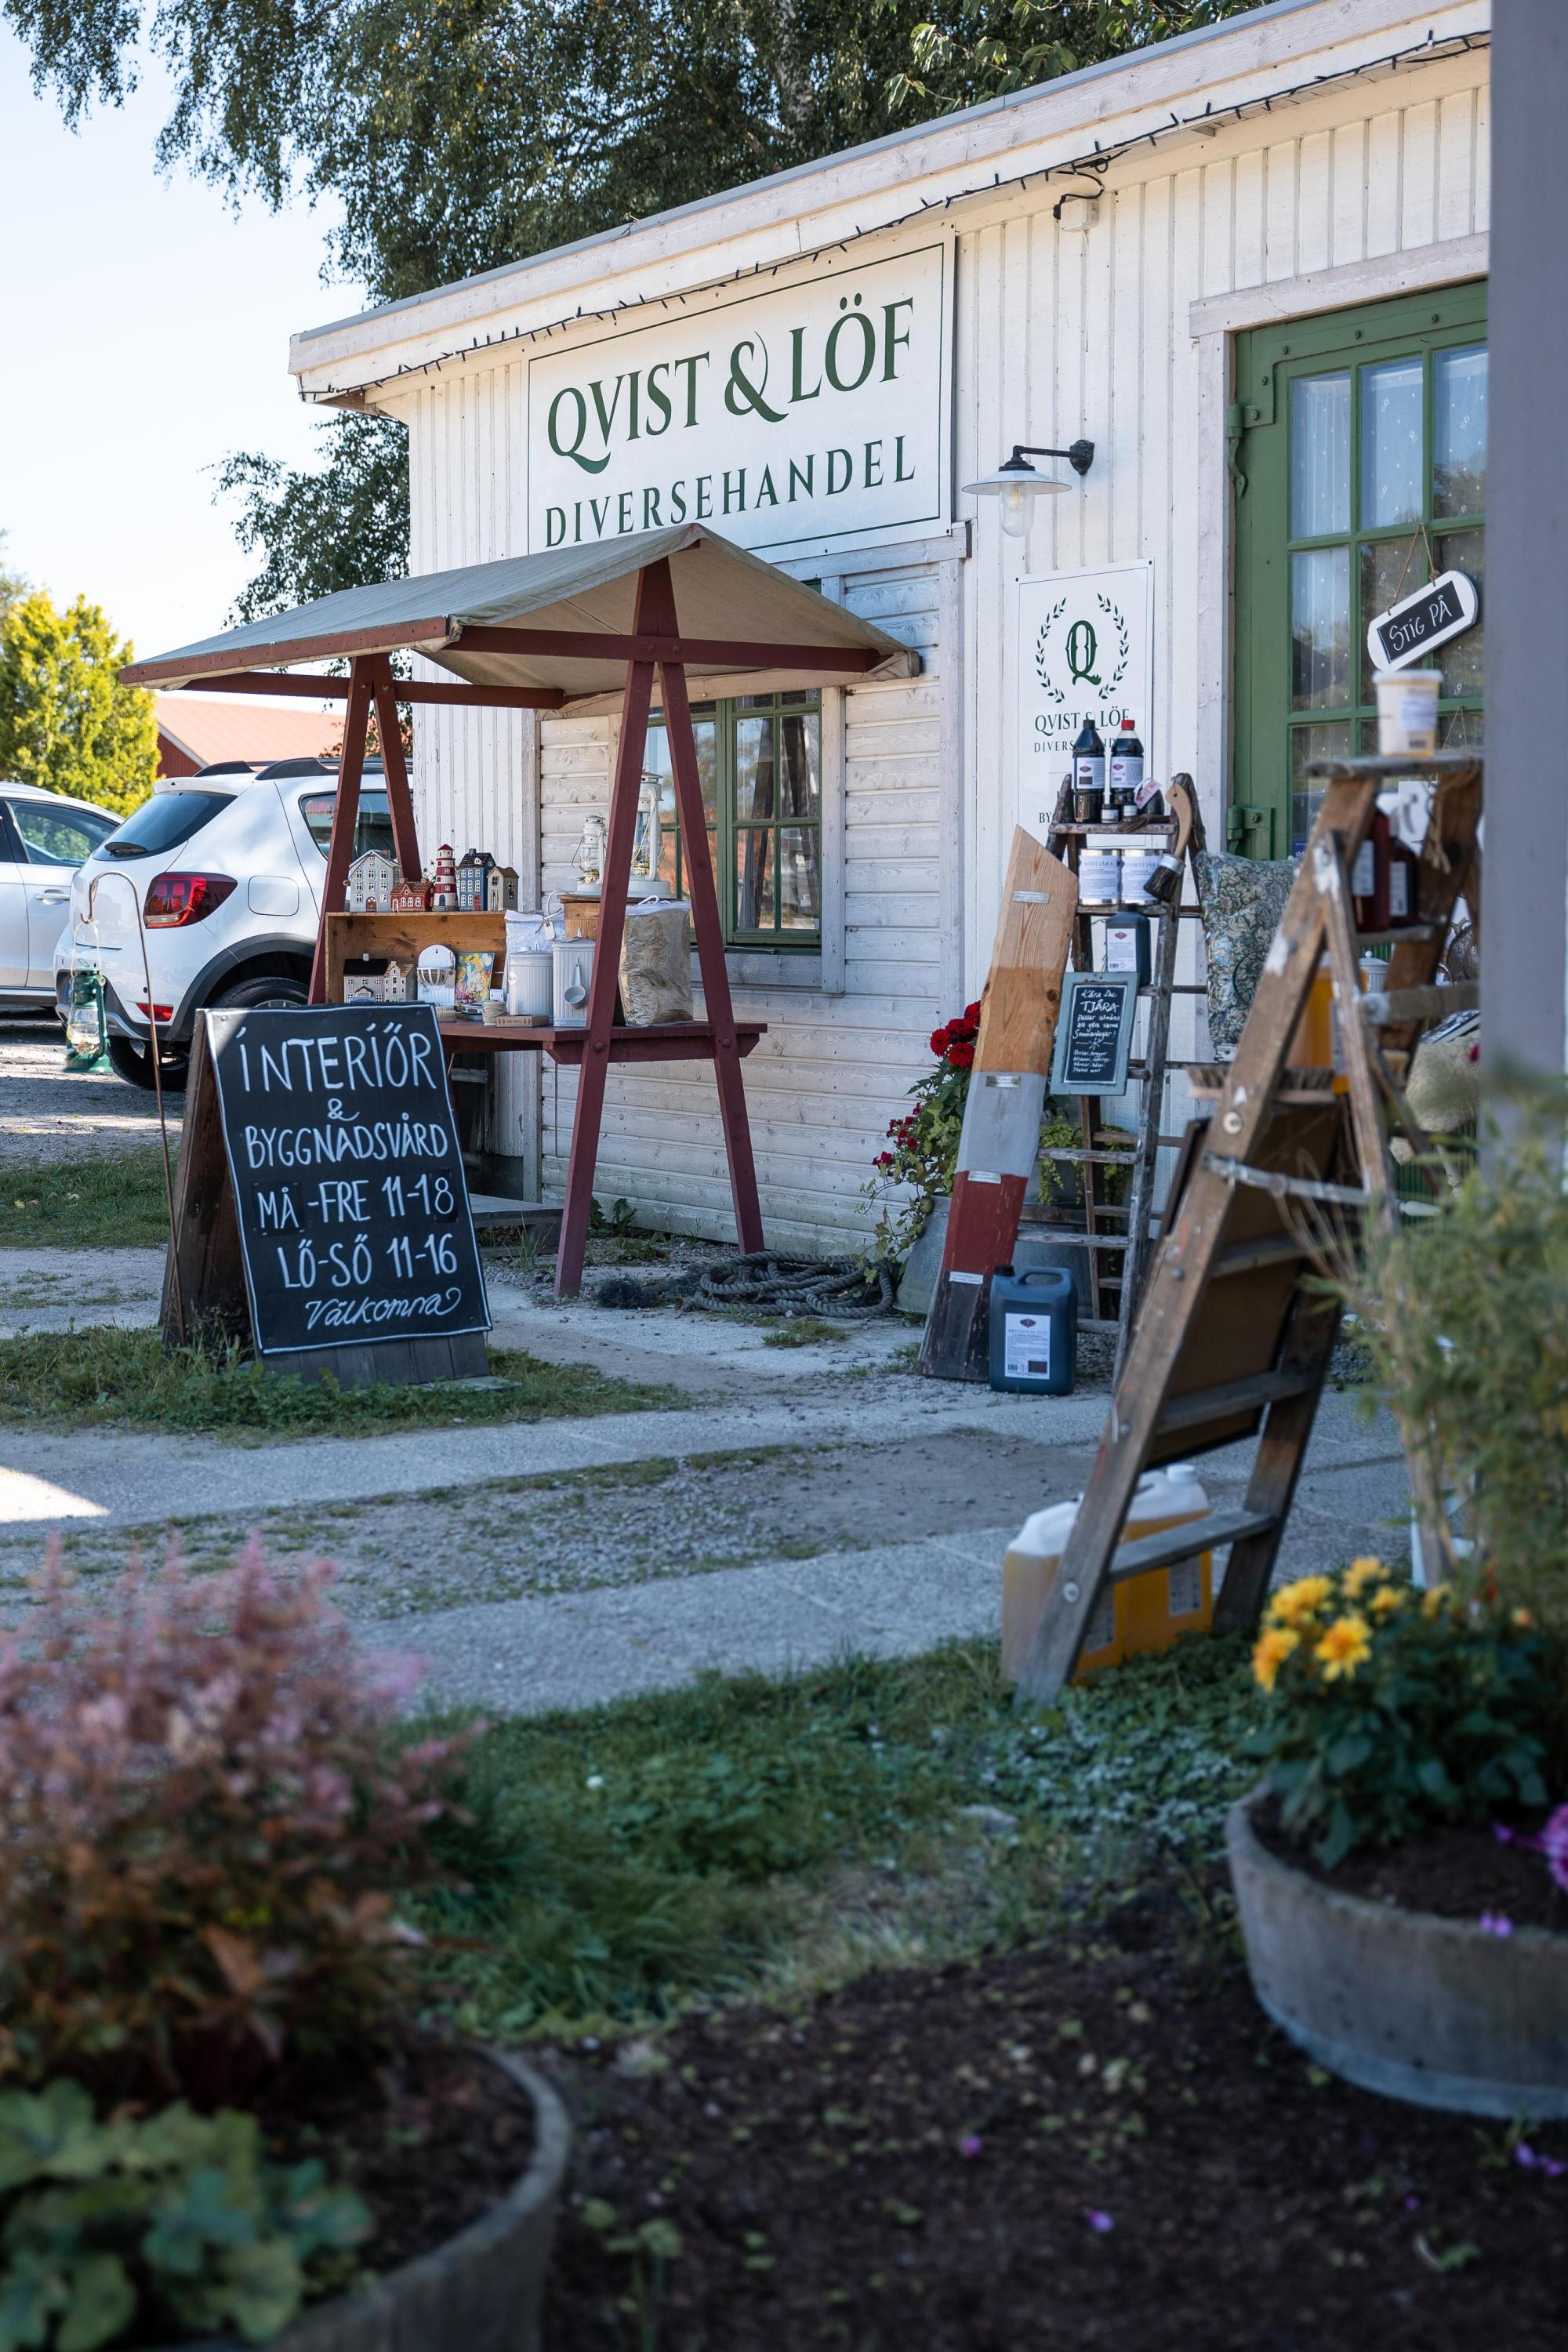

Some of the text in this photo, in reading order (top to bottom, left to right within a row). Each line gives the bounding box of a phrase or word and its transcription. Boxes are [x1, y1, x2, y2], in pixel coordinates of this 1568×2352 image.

[548, 292, 913, 474] QVIST & LÖF
[546, 434, 916, 548] DIVERSEHANDEL
[1428, 594, 1453, 627] PÅ
[1035, 712, 1080, 736] QVIST
[1080, 998, 1120, 1013] TJÄRA
[236, 1022, 437, 1092] INTERIÖR
[327, 1098, 360, 1121] &
[245, 1112, 448, 1169] BYGGNADSVÅRD
[257, 1185, 299, 1230] MÅ
[381, 1174, 455, 1217] 11-18
[277, 1233, 458, 1290] LÖ-SÖ 11-16
[305, 1287, 462, 1330] Välkomna
